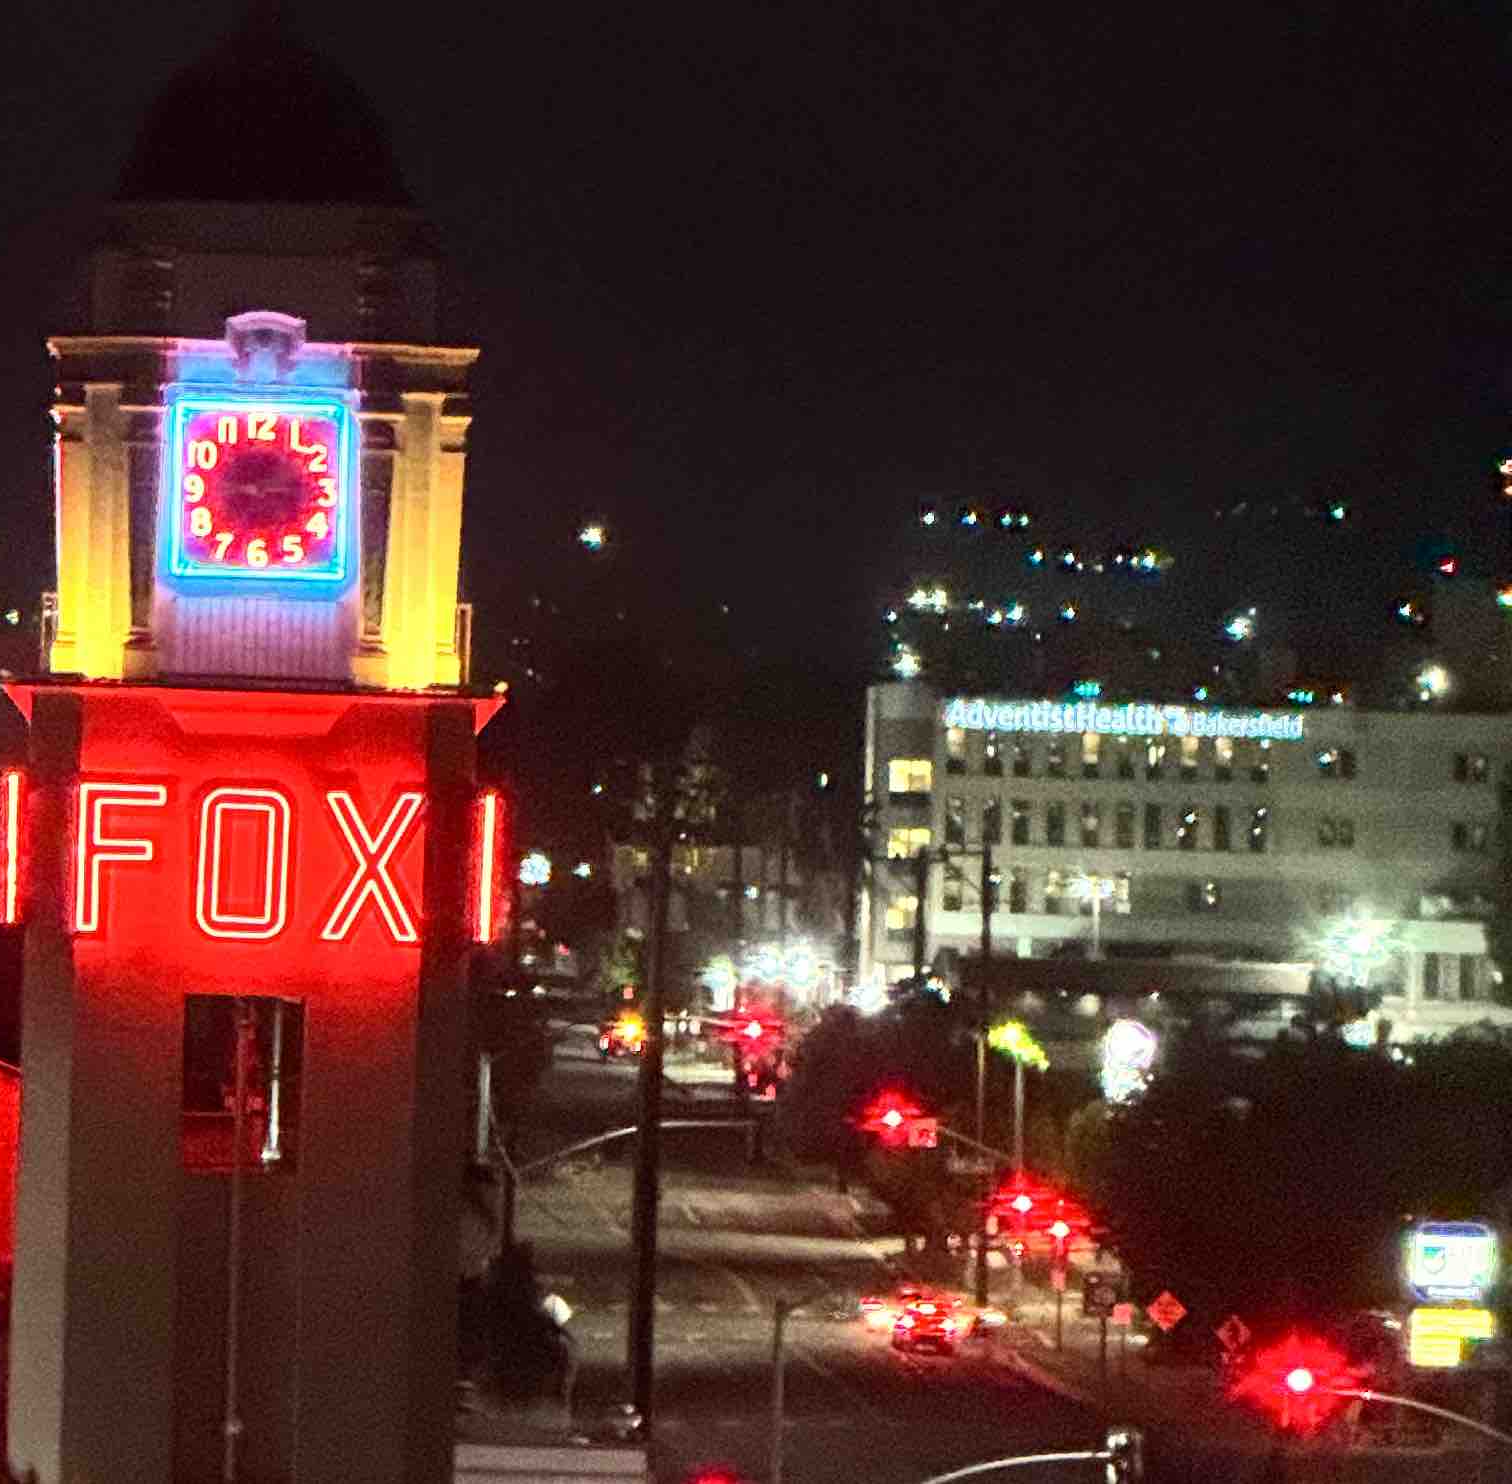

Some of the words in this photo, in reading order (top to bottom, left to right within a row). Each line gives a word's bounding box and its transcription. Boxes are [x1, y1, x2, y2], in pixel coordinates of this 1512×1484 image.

[217, 415, 238, 444] 11
[247, 413, 277, 440] 12
[188, 440, 218, 470] 10
[308, 444, 329, 473] 2
[184, 474, 205, 503] 9
[317, 478, 338, 507] 3
[190, 506, 213, 537] 8
[305, 511, 329, 540] 4
[215, 532, 234, 560] 7
[247, 538, 269, 567] 6
[282, 534, 304, 562] 5
[1193, 711, 1303, 738] Bakersfield
[75, 782, 424, 942] FOX
